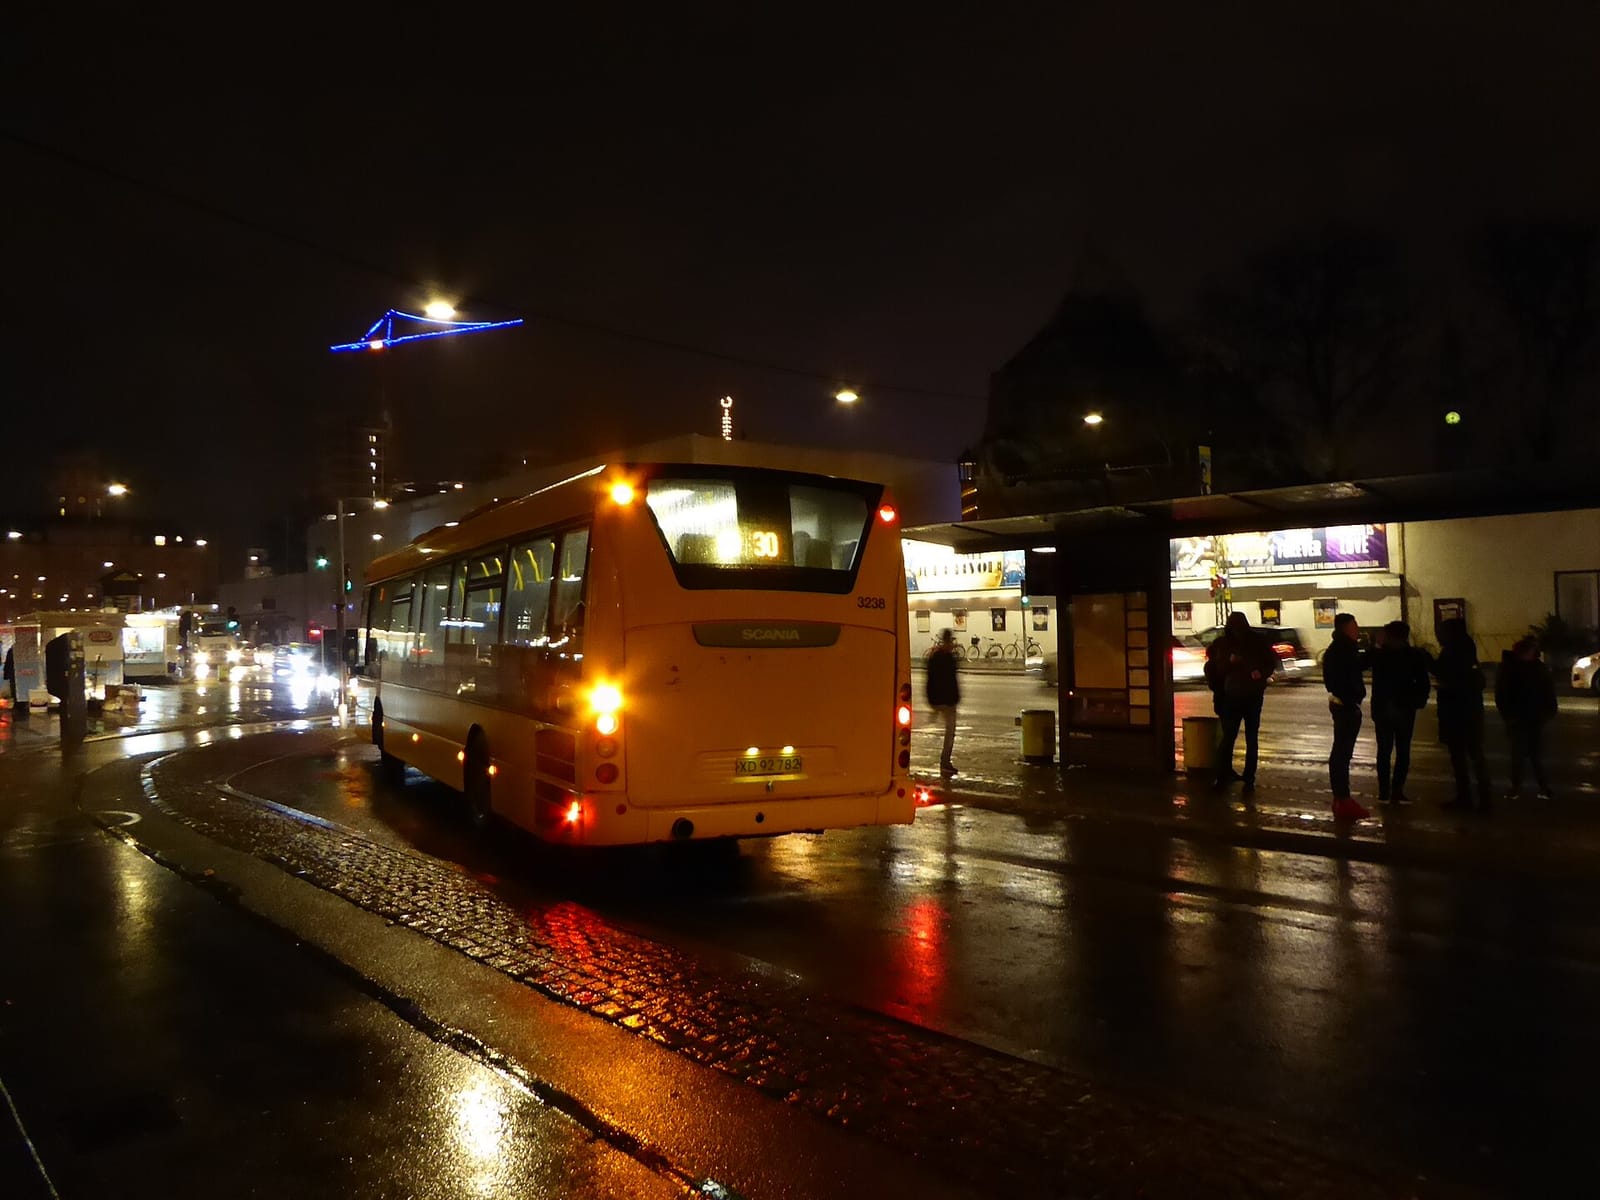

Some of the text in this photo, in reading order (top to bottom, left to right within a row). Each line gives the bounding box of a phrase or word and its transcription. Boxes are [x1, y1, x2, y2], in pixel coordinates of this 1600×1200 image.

[753, 531, 779, 557] 30
[1277, 539, 1322, 558] FOREVER
[1340, 535, 1370, 555] LOVE
[857, 597, 886, 609] 3238
[742, 629, 800, 641] SCANIA
[739, 758, 800, 773] XD 92 782
